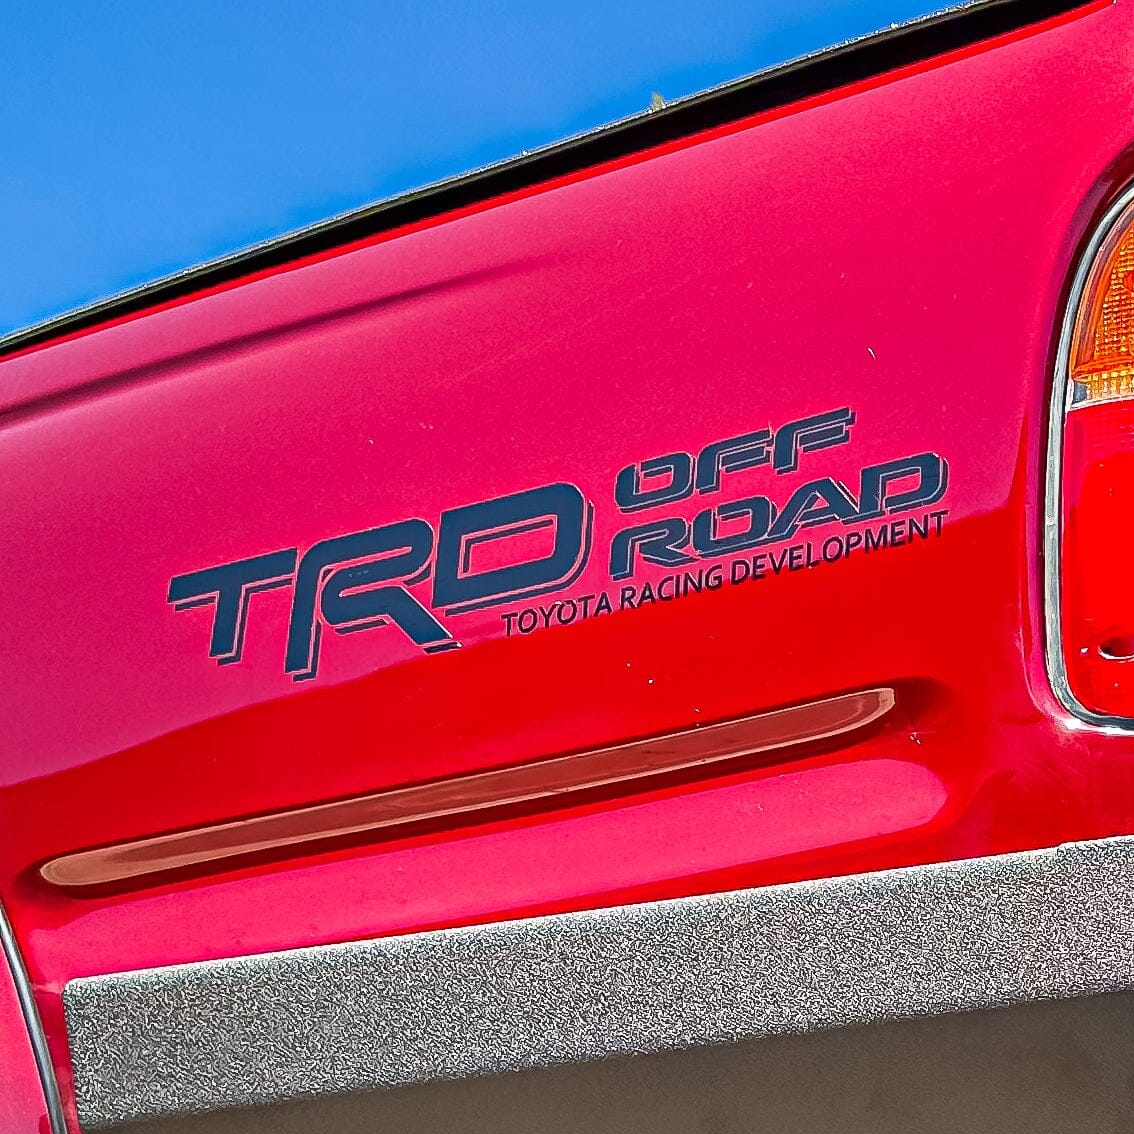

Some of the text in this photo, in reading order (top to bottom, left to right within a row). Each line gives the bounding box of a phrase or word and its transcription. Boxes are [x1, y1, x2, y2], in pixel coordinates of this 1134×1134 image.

[609, 452, 949, 581] ROAD
[615, 407, 855, 513] OFF
[168, 482, 594, 682] TRD
[502, 510, 949, 637] TOYOTA RACING DEVELOPMENT
